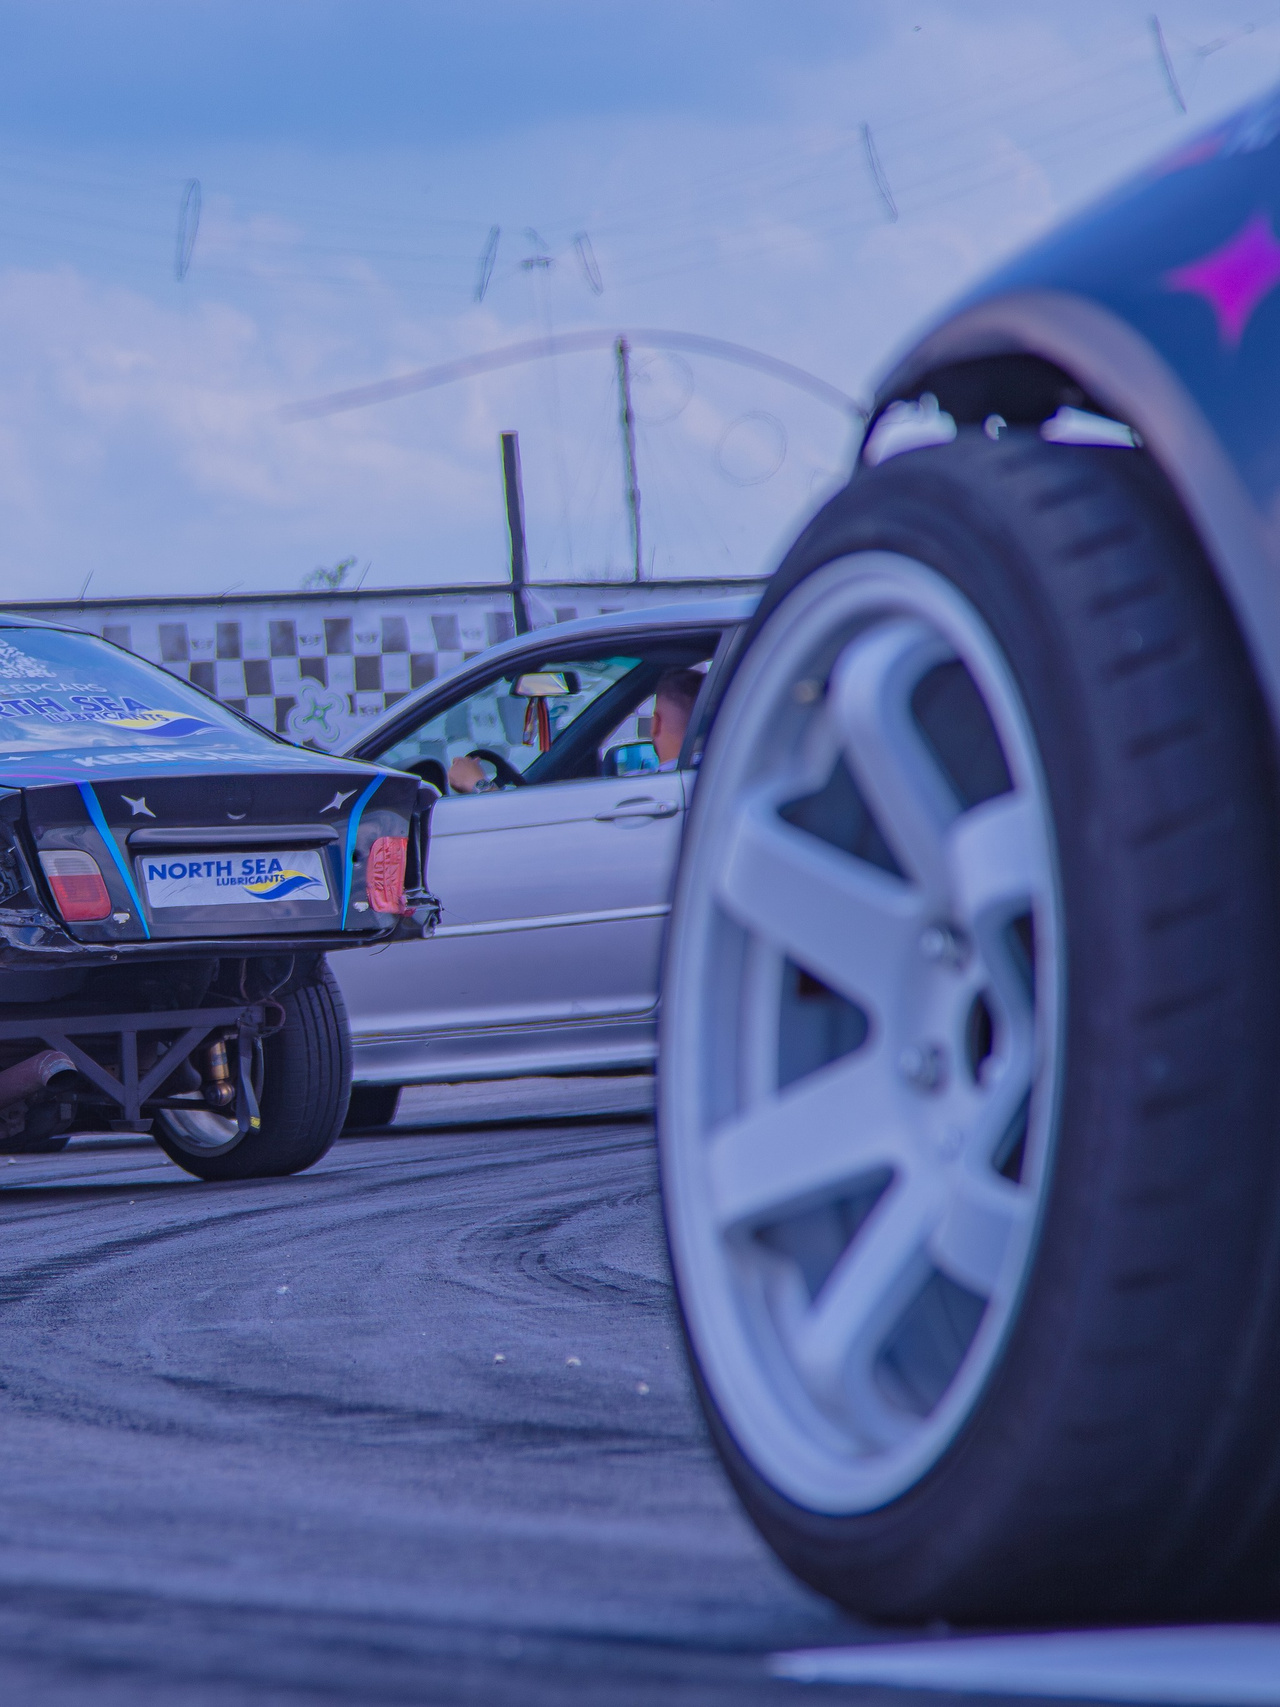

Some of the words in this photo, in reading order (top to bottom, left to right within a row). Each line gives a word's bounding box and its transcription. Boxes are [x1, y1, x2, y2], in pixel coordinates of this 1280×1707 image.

[70, 695, 154, 713] SEA
[43, 711, 171, 723] LUBRICANTS
[148, 860, 232, 881] NORTH
[241, 858, 283, 874] SEA
[216, 874, 286, 887] LUBRICANTS
